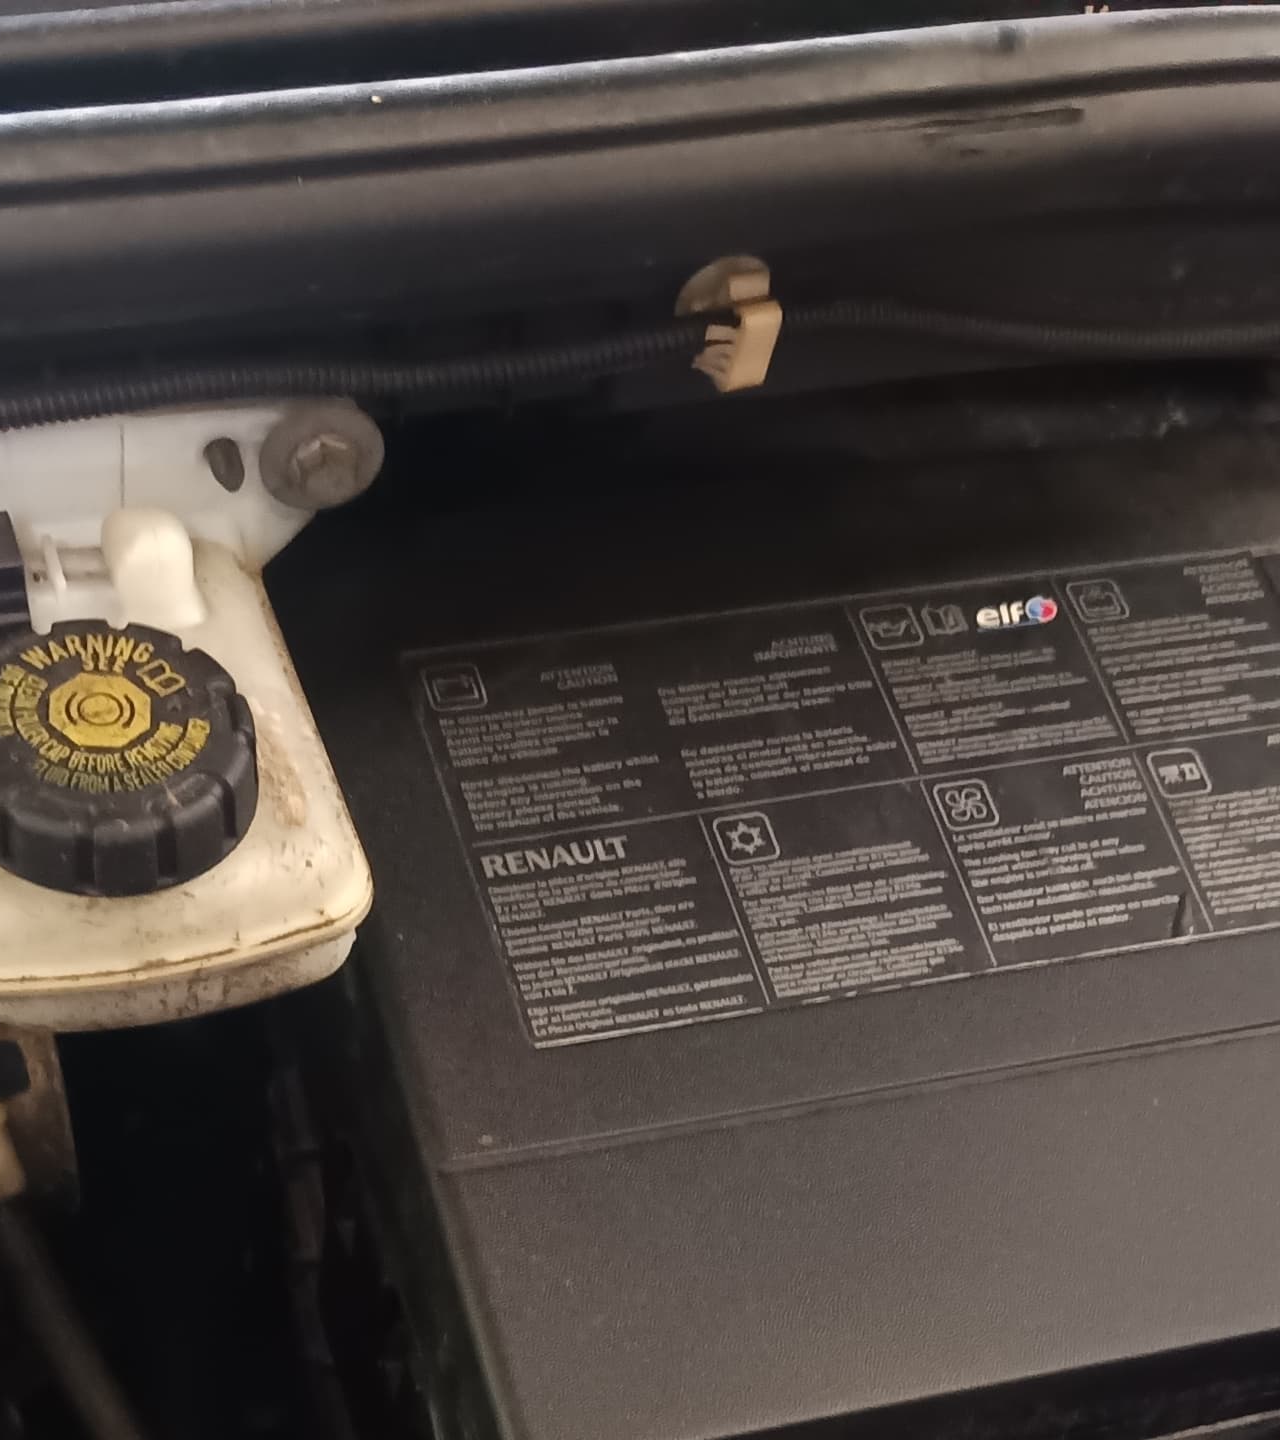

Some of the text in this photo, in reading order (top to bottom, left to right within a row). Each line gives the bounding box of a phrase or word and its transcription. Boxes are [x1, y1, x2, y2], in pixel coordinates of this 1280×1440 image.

[976, 601, 1024, 629] elf
[20, 633, 155, 671] WARNING
[81, 650, 127, 674] SEE
[39, 742, 70, 764] CAP
[68, 751, 126, 773] BEFORE
[1063, 757, 1131, 776] ATTENTION
[70, 771, 109, 793] FROM
[1079, 769, 1137, 785] CAUTION
[1080, 780, 1142, 798] ACHTUNG
[482, 836, 626, 877] RENAULT
